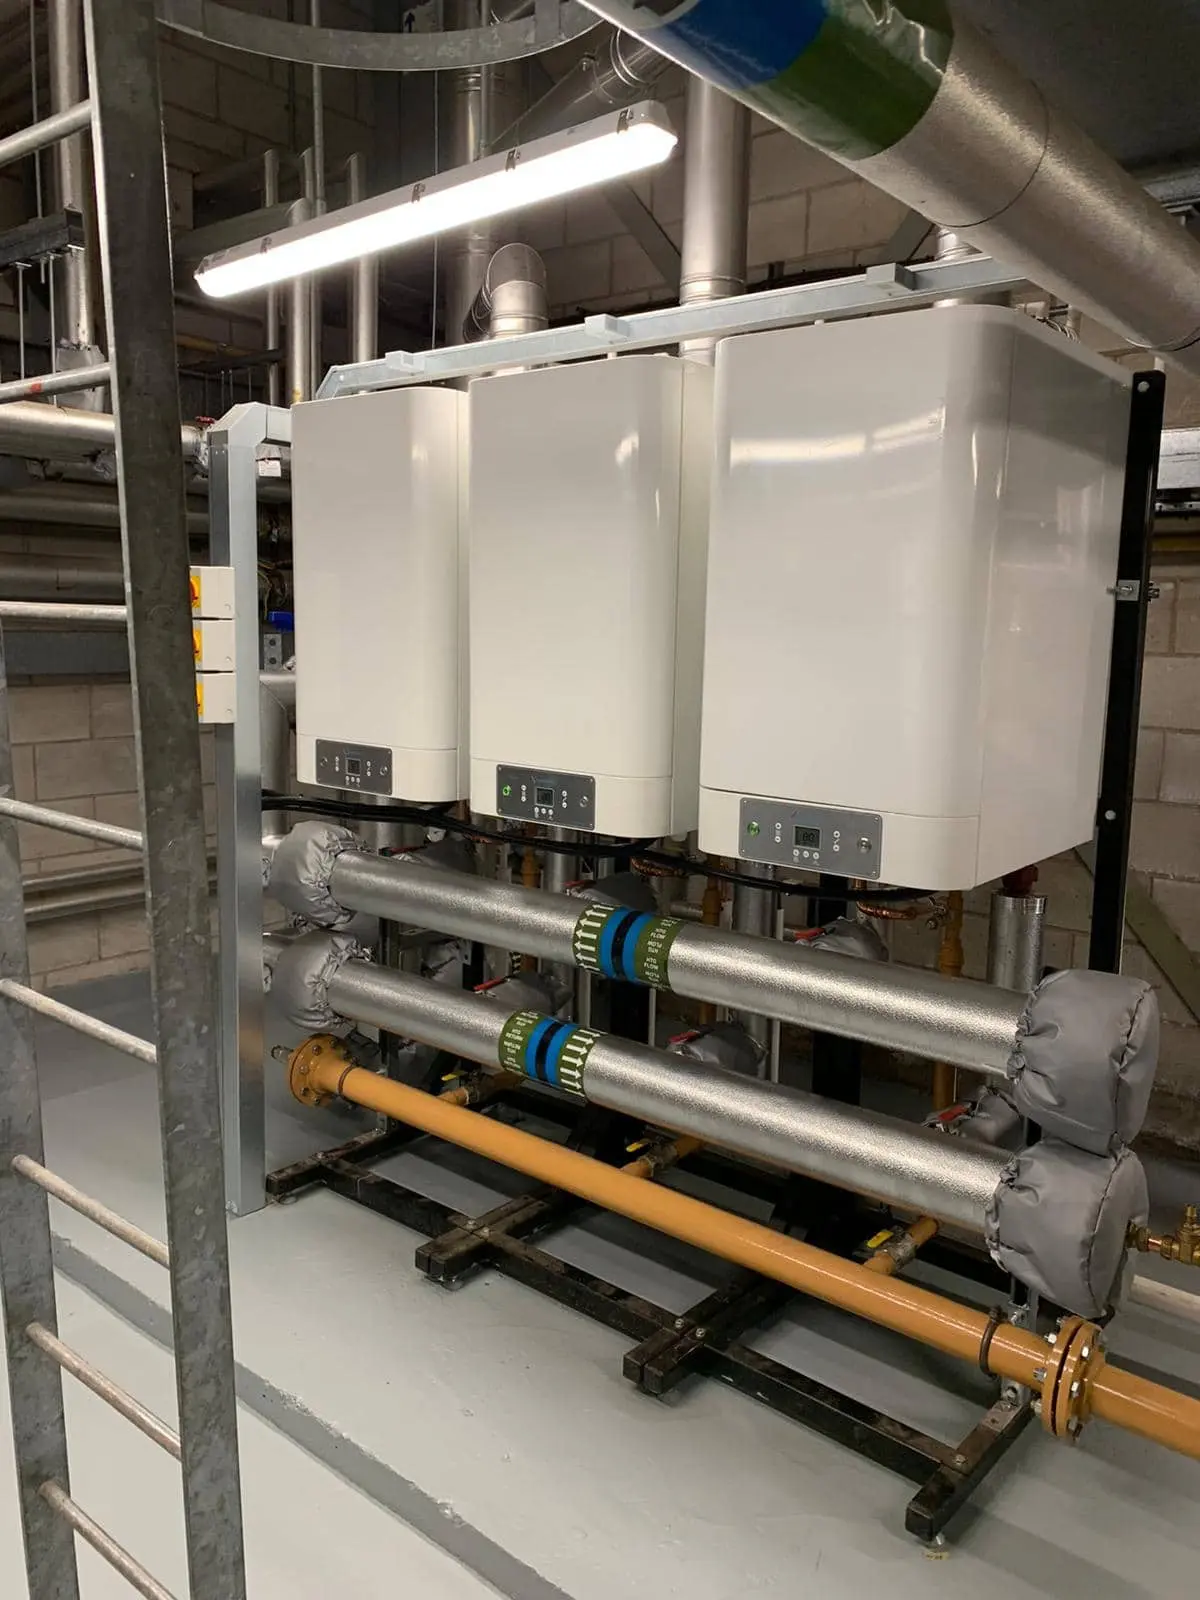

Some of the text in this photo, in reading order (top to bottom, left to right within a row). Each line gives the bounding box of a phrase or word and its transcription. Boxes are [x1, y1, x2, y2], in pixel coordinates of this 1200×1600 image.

[650, 932, 667, 940] FLOW
[643, 962, 658, 970] FLOW
[505, 1032, 523, 1041] RETURN
